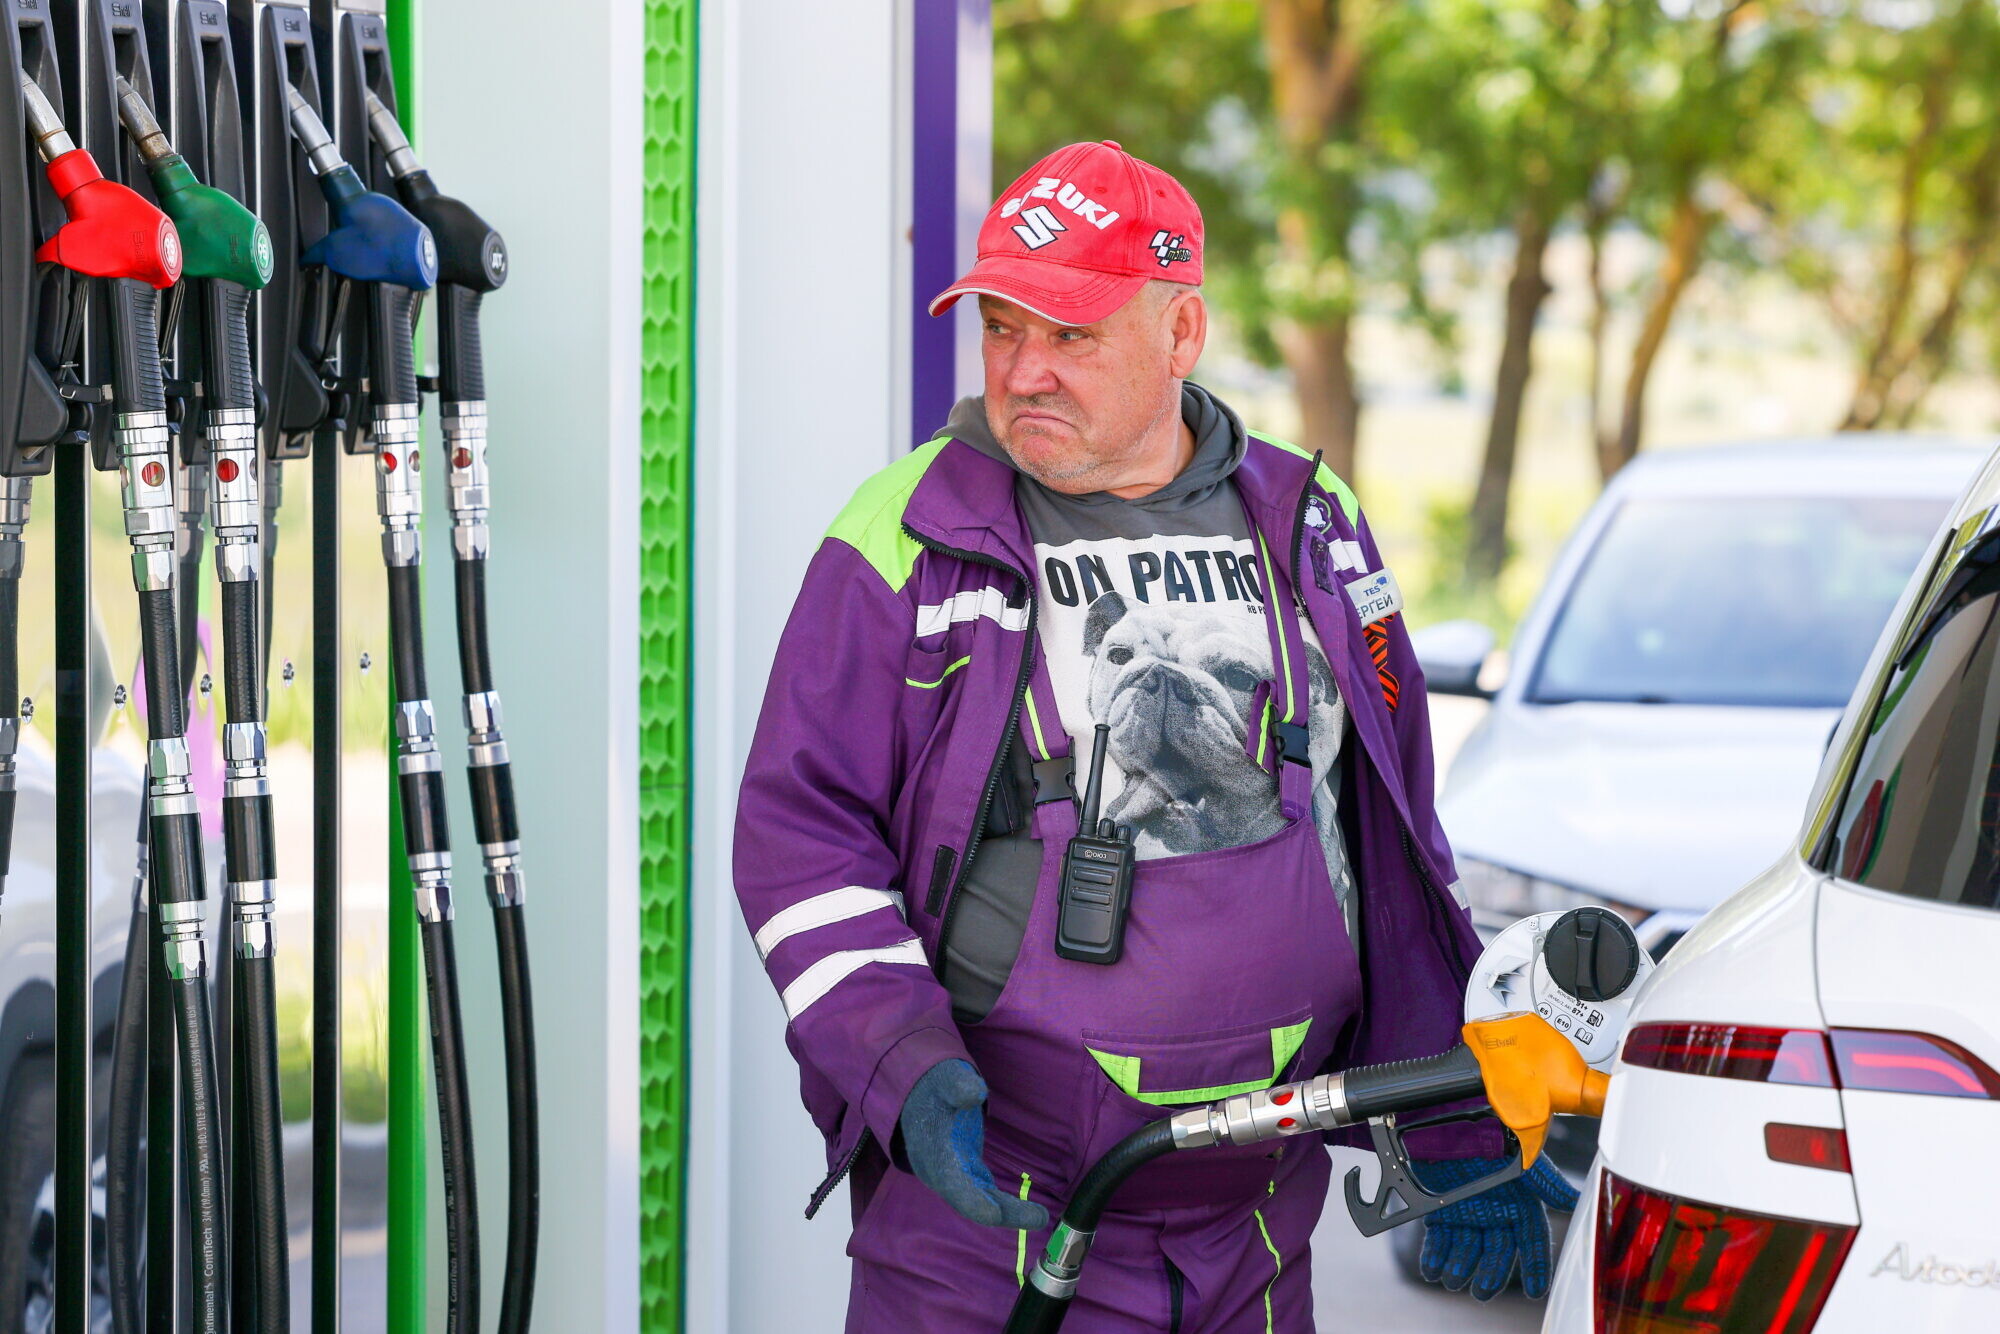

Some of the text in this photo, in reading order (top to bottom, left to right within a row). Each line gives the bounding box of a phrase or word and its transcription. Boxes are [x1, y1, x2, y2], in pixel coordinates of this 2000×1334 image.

[1000, 176, 1120, 230] SZUKI
[1045, 550, 1264, 606] ON PATRO
[1363, 585, 1381, 597] TES
[186, 1004, 197, 1018] USA
[1540, 1007, 1549, 1016] E5
[1571, 1007, 1584, 1017] 87+
[1576, 1000, 1588, 1010] 91+
[1556, 1018, 1570, 1028] E10
[189, 1029, 199, 1048] MADE
[192, 1067, 204, 1100] GASOLINE
[196, 1112, 207, 1131] STYLE
[203, 1227, 214, 1277] ContiTech
[205, 1291, 216, 1334] ontinental
